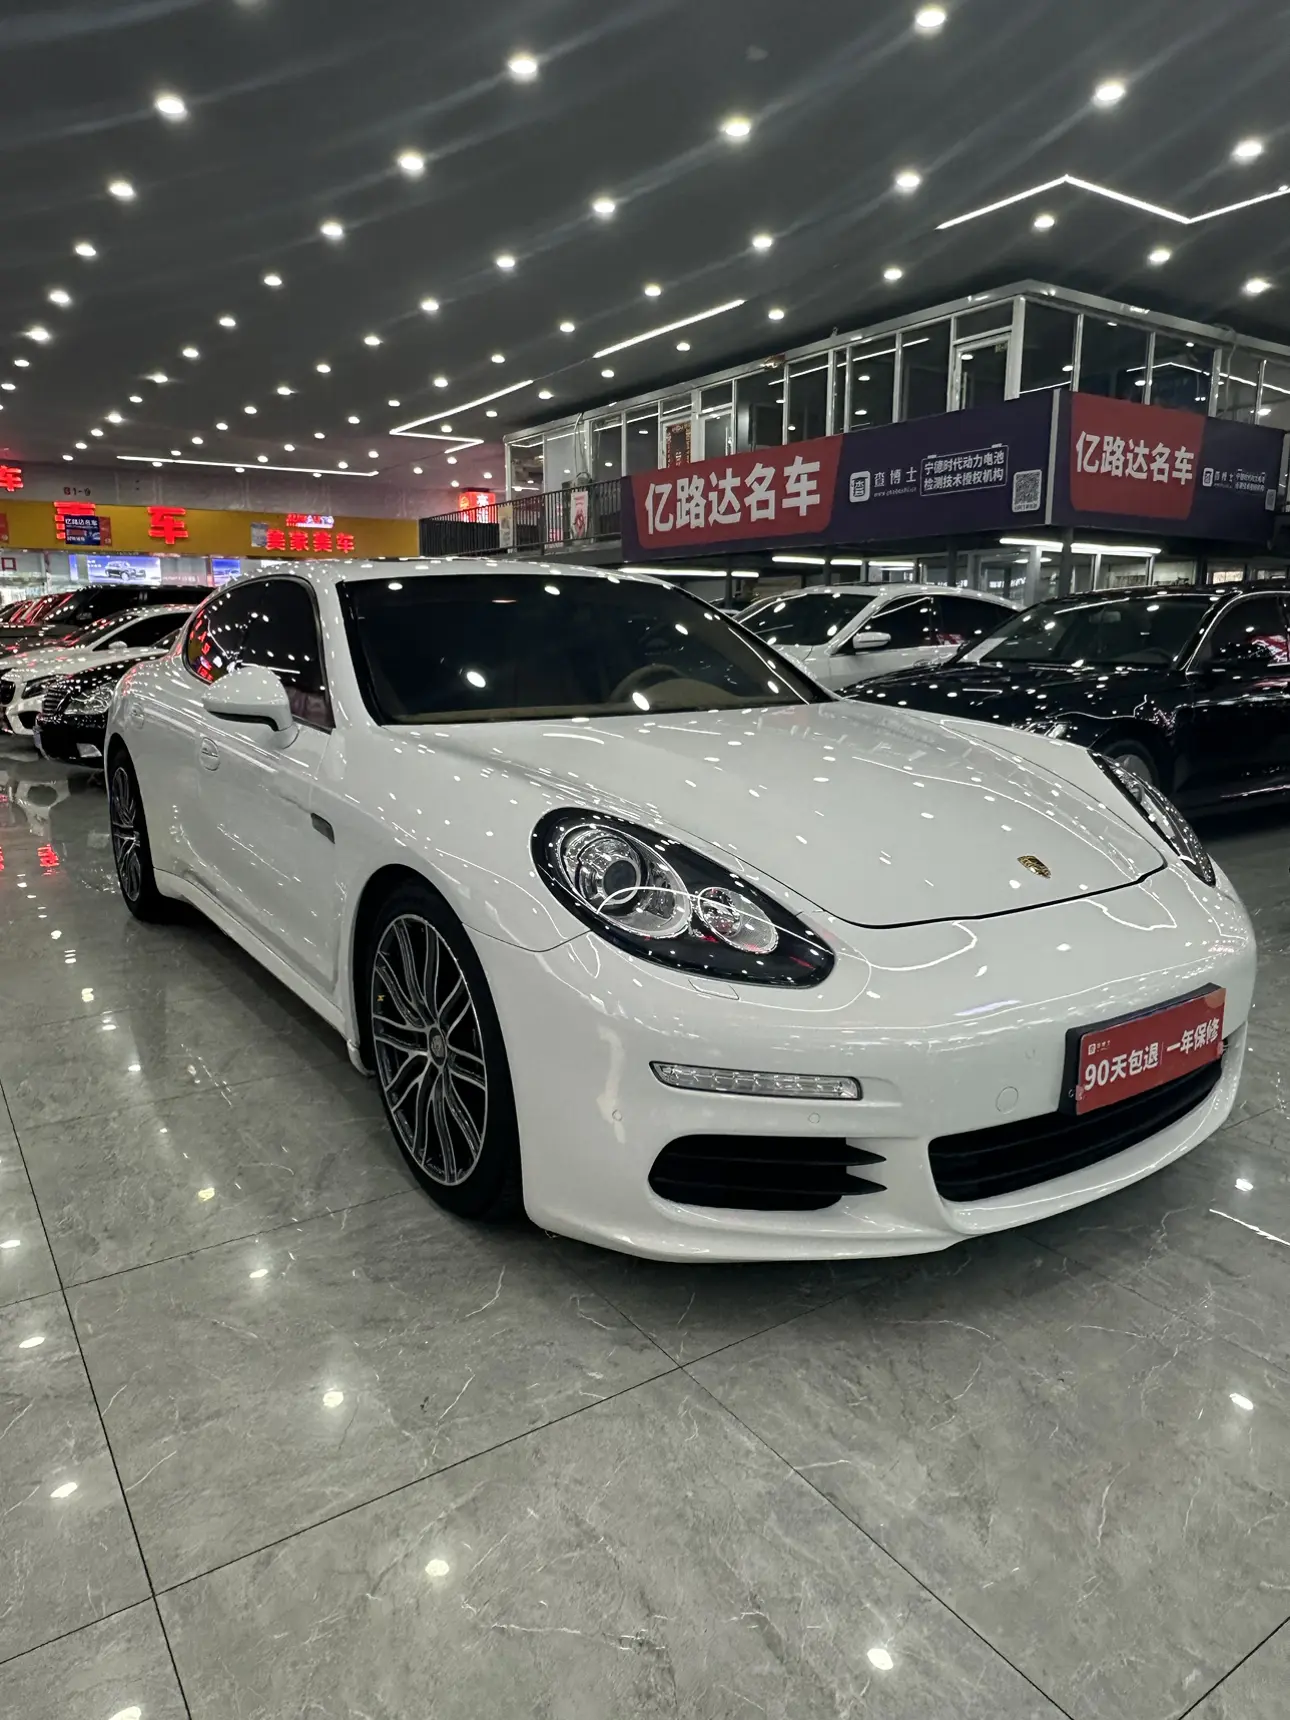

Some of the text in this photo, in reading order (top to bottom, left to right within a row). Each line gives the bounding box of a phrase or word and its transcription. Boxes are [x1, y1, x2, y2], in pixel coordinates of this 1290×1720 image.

[924, 450, 1004, 476] 宁德时代动力电池
[1076, 431, 1194, 485] 亿路达名车
[645, 456, 820, 534] 亿路达名车
[924, 468, 1004, 491] 检测技术授权机构
